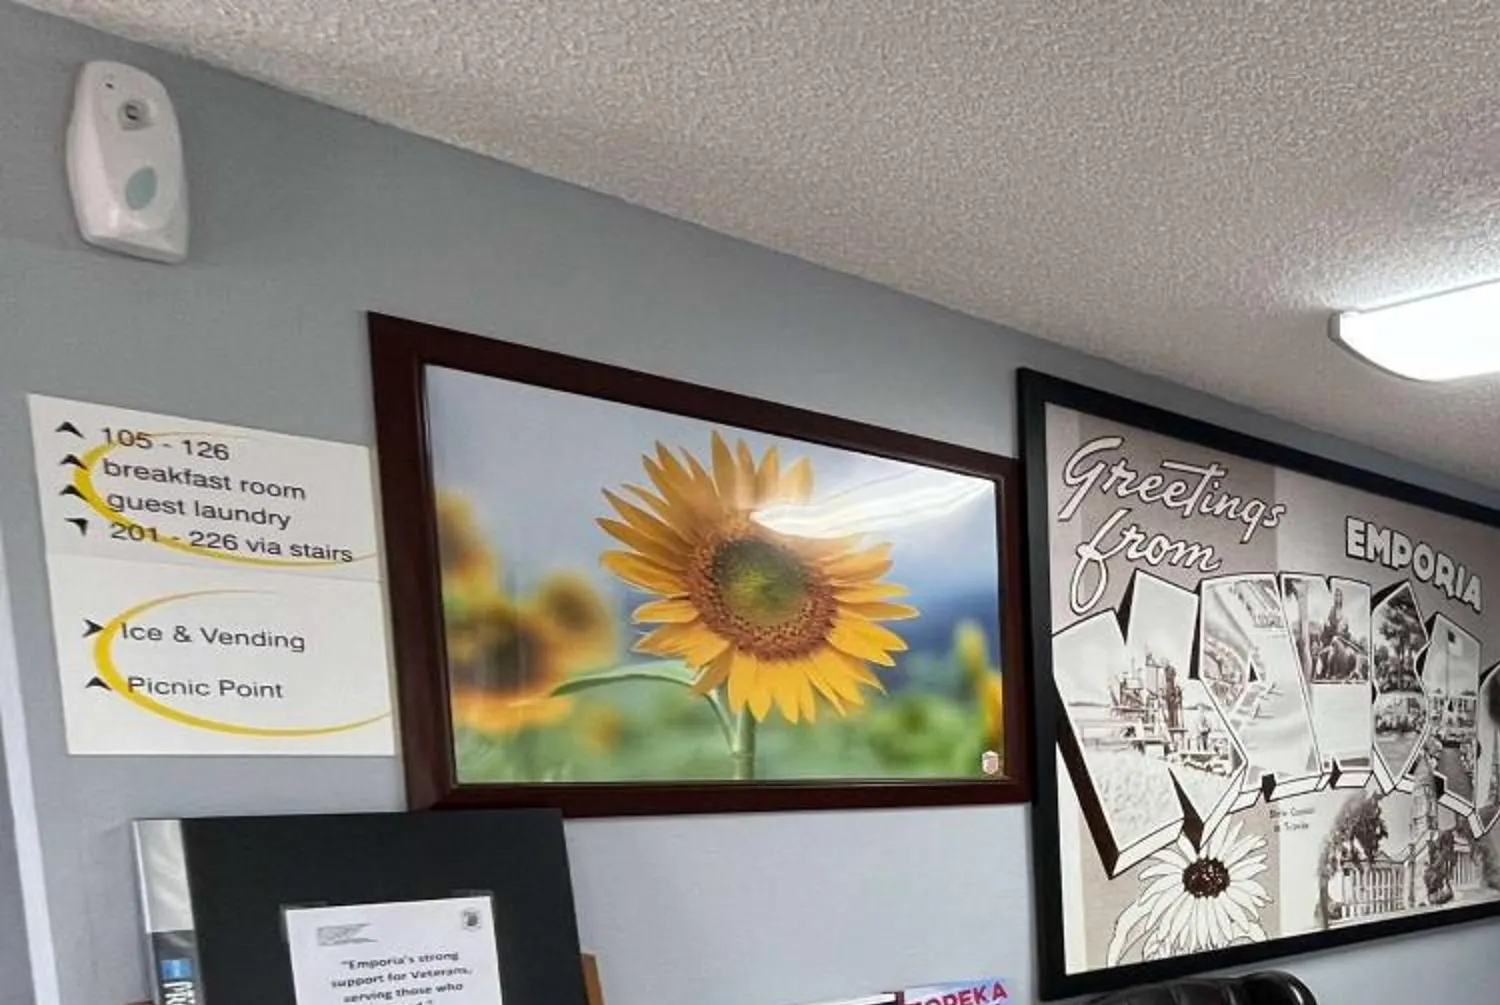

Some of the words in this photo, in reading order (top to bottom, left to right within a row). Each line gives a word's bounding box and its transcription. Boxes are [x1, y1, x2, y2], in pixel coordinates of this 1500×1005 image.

[101, 427, 153, 449] 105
[184, 440, 230, 461] 126
[103, 459, 232, 490] breakfast
[240, 478, 306, 500] room
[1058, 436, 1286, 543] Greetings
[107, 493, 186, 517] guest
[194, 500, 291, 530] laundry
[111, 522, 161, 542] 201
[189, 530, 238, 551] 226
[245, 537, 282, 556] via
[290, 541, 354, 562] stairs
[1069, 509, 1222, 614] from
[1345, 516, 1483, 612] EMPORIA
[121, 622, 163, 642] Ice
[173, 624, 192, 643] &
[200, 626, 306, 653] Vending
[127, 677, 211, 697] Picnic
[219, 680, 284, 699] Point
[418, 952, 459, 963] strong
[331, 975, 385, 989] support
[387, 972, 407, 983] for
[344, 990, 393, 1004] serving
[396, 986, 433, 997] those
[436, 982, 464, 993] who
